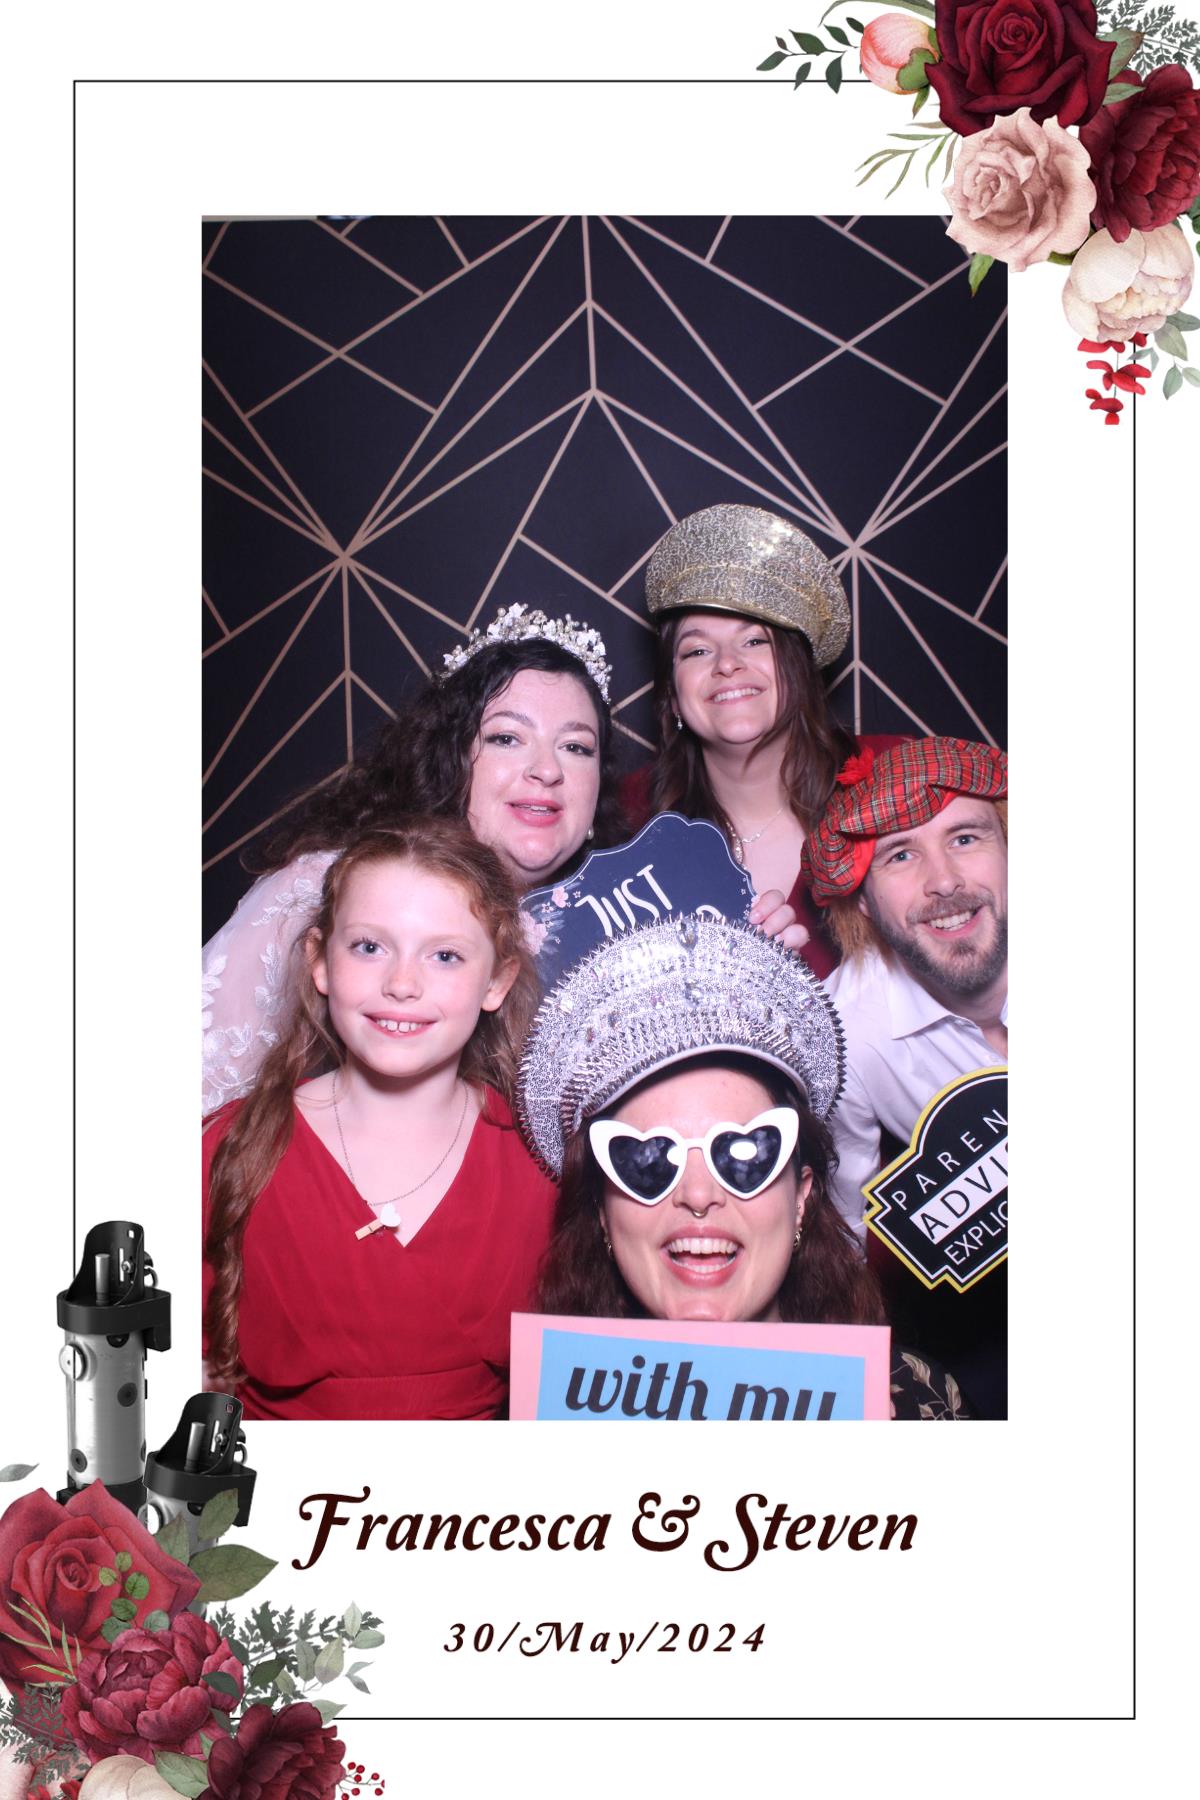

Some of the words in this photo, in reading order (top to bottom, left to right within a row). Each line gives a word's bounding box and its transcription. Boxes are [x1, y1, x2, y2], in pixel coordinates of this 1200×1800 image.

[574, 864, 673, 938] JUST
[891, 1109, 1008, 1211] PAREN
[920, 1142, 1008, 1240] ADVI
[564, 1355, 708, 1420] with
